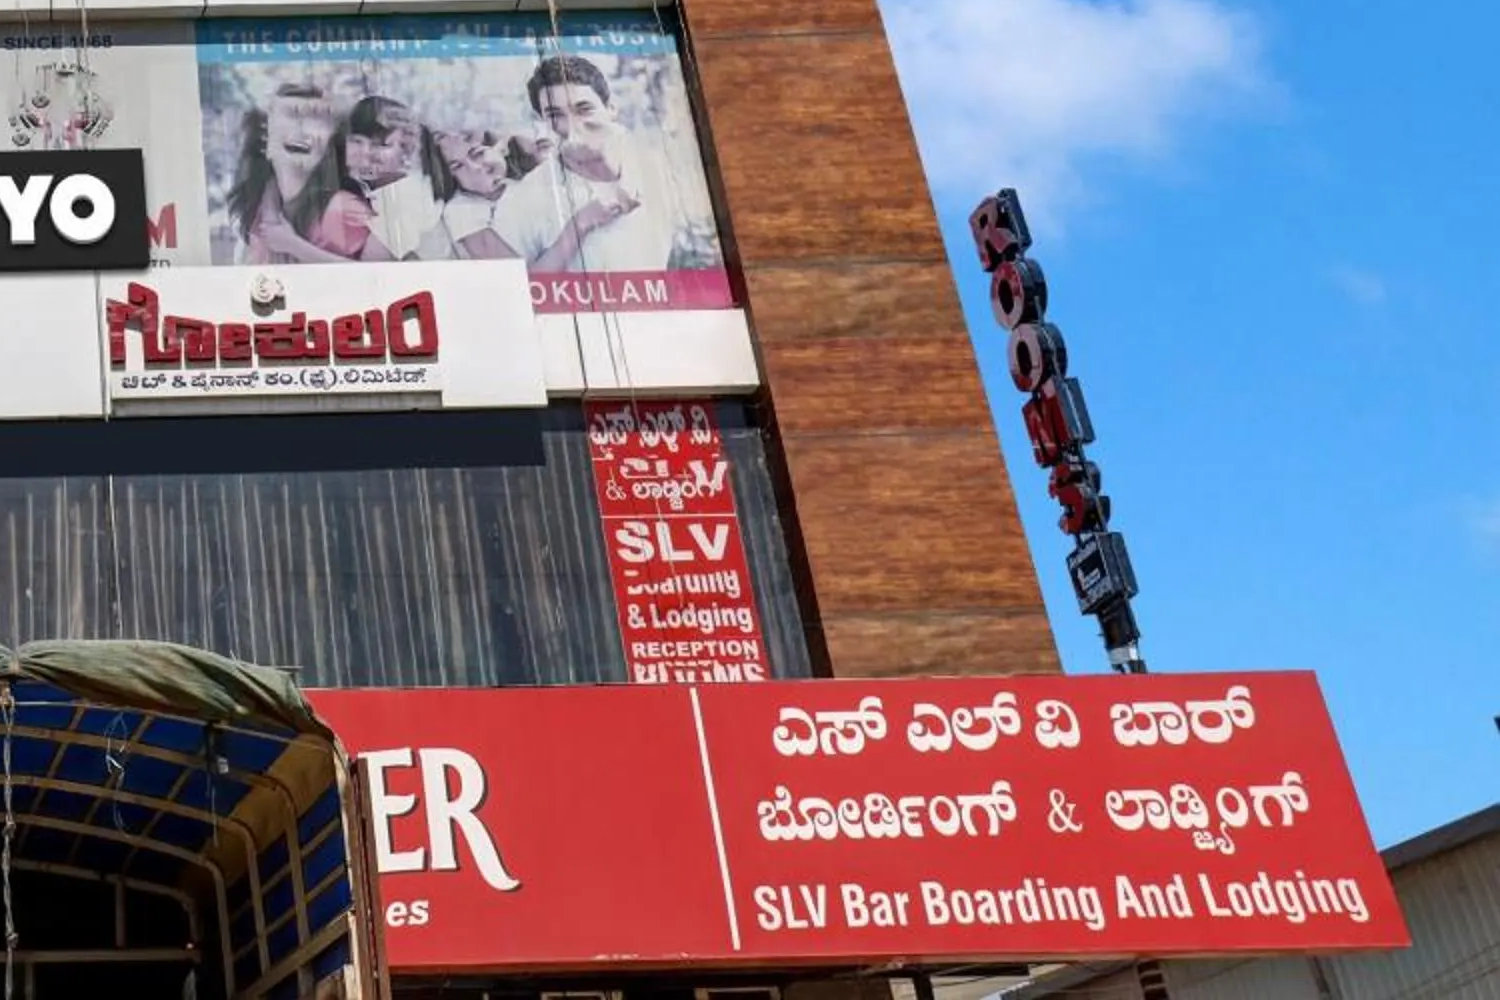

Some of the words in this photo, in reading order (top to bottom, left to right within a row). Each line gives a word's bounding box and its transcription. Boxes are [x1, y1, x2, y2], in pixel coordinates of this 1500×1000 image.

[615, 520, 730, 563] SLV
[628, 603, 646, 629] &
[649, 602, 754, 634] Lodging
[631, 639, 760, 660] RECEPTION
[772, 695, 887, 756] ಎಸ್
[907, 691, 1021, 753] ಎಲ್
[1035, 698, 1081, 749] ವಿ
[1110, 685, 1256, 746] ಬಾರ್
[1047, 788, 1084, 833] &
[753, 884, 827, 932] SLV
[840, 882, 910, 928] Bar
[920, 877, 1105, 931] Boarding
[1115, 873, 1194, 919] And
[1198, 869, 1370, 924] Lodging
